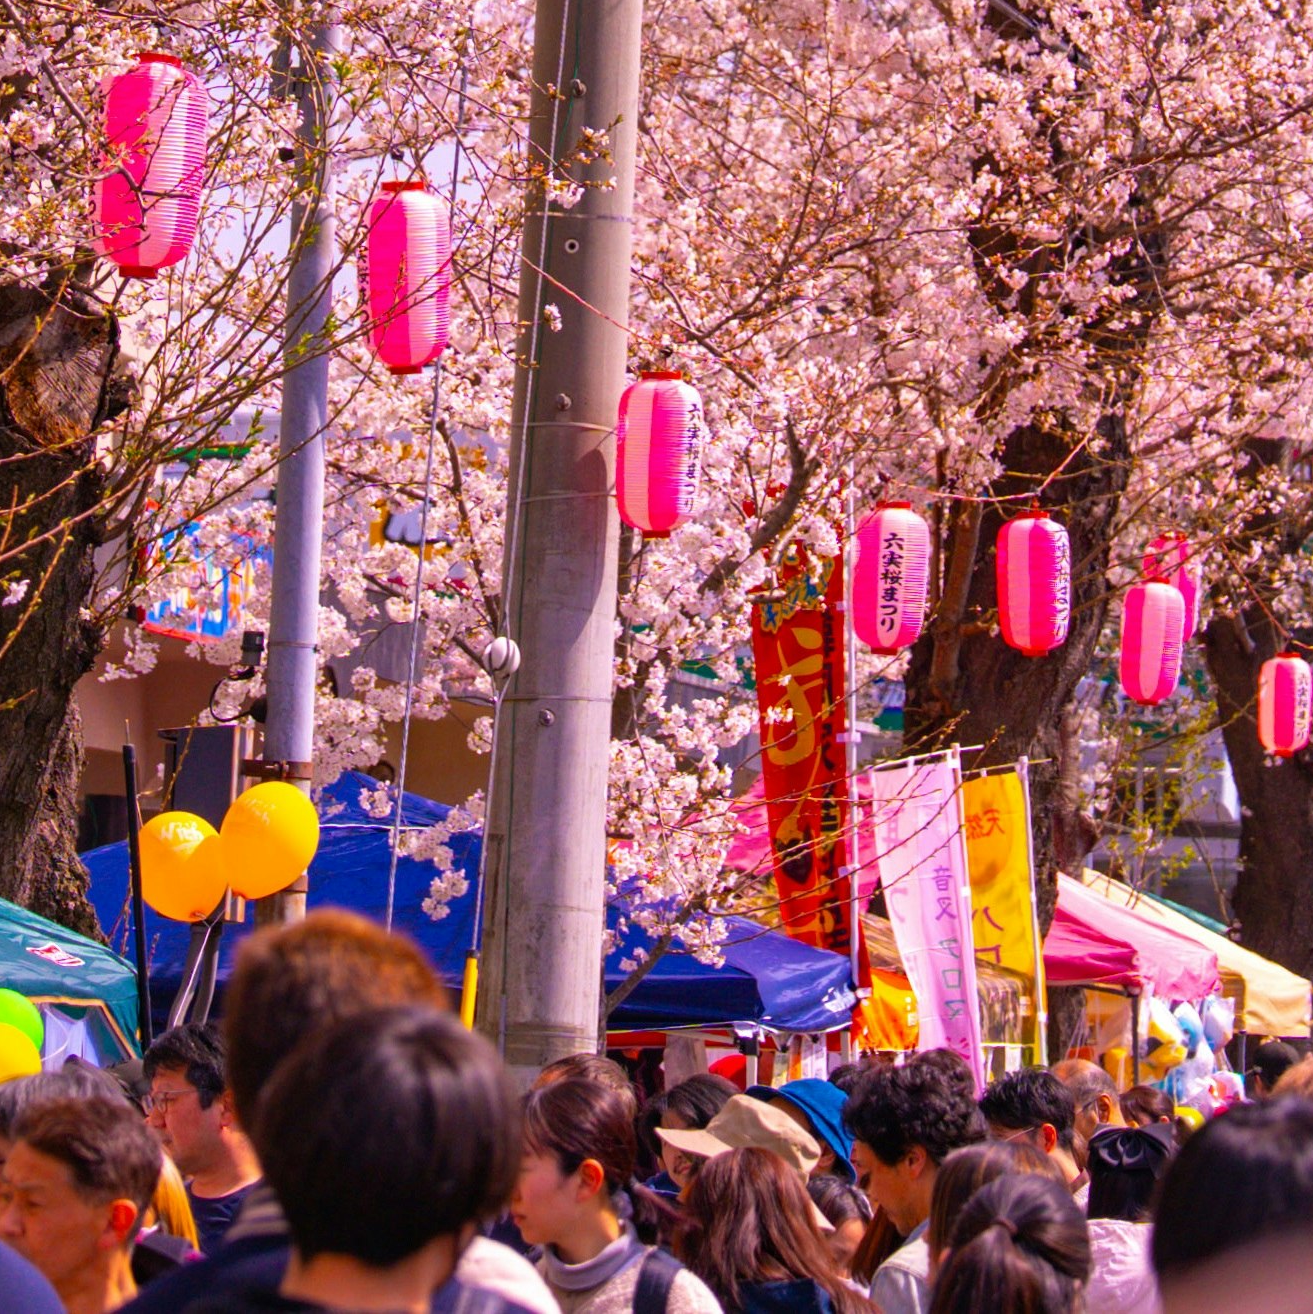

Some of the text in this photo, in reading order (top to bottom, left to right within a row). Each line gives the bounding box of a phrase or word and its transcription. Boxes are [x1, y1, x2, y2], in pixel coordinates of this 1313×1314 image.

[685, 403, 701, 513] 六実桜まつり
[879, 532, 905, 633] 六実桜まつり
